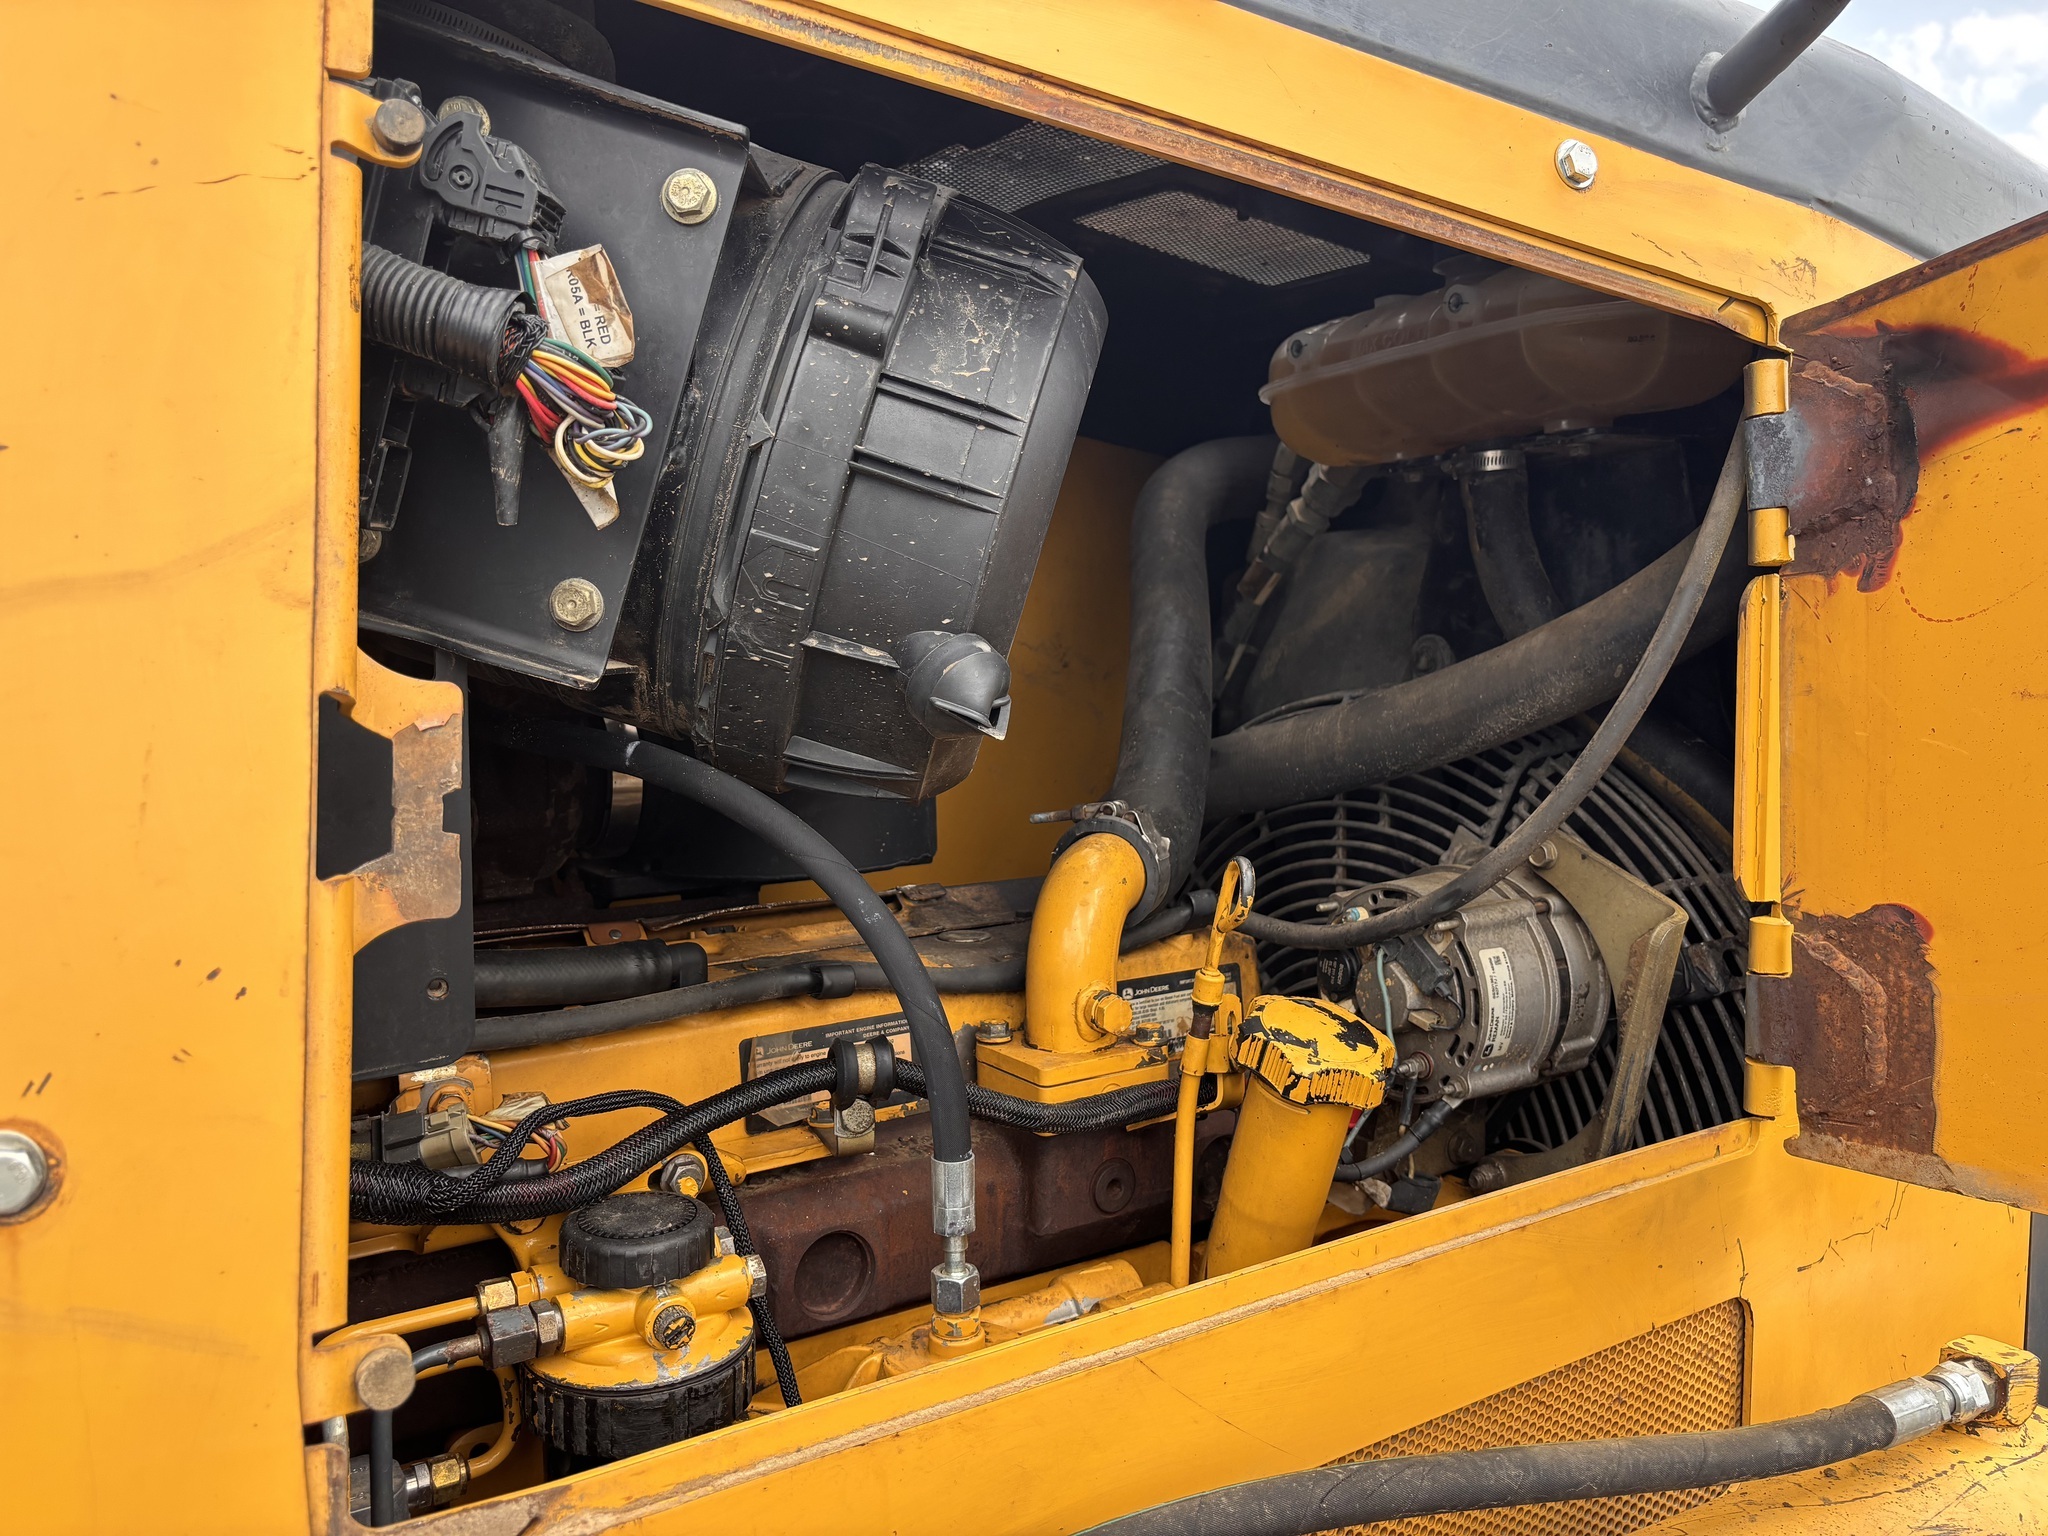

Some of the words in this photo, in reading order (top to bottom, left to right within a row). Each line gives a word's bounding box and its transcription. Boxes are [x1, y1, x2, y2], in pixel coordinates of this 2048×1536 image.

[579, 319, 598, 349] BLK
[594, 315, 612, 345] RED
[1135, 988, 1151, 996] JOHN
[1150, 984, 1170, 993] DEERE
[825, 1028, 855, 1038] IMPORTANT
[856, 1024, 875, 1033] ENGINE
[862, 1030, 880, 1038] DEERE
[885, 1025, 910, 1034] COMPANY
[766, 1045, 788, 1055] JOHN
[788, 1040, 813, 1051] DEERE
[810, 1049, 827, 1059] engine
